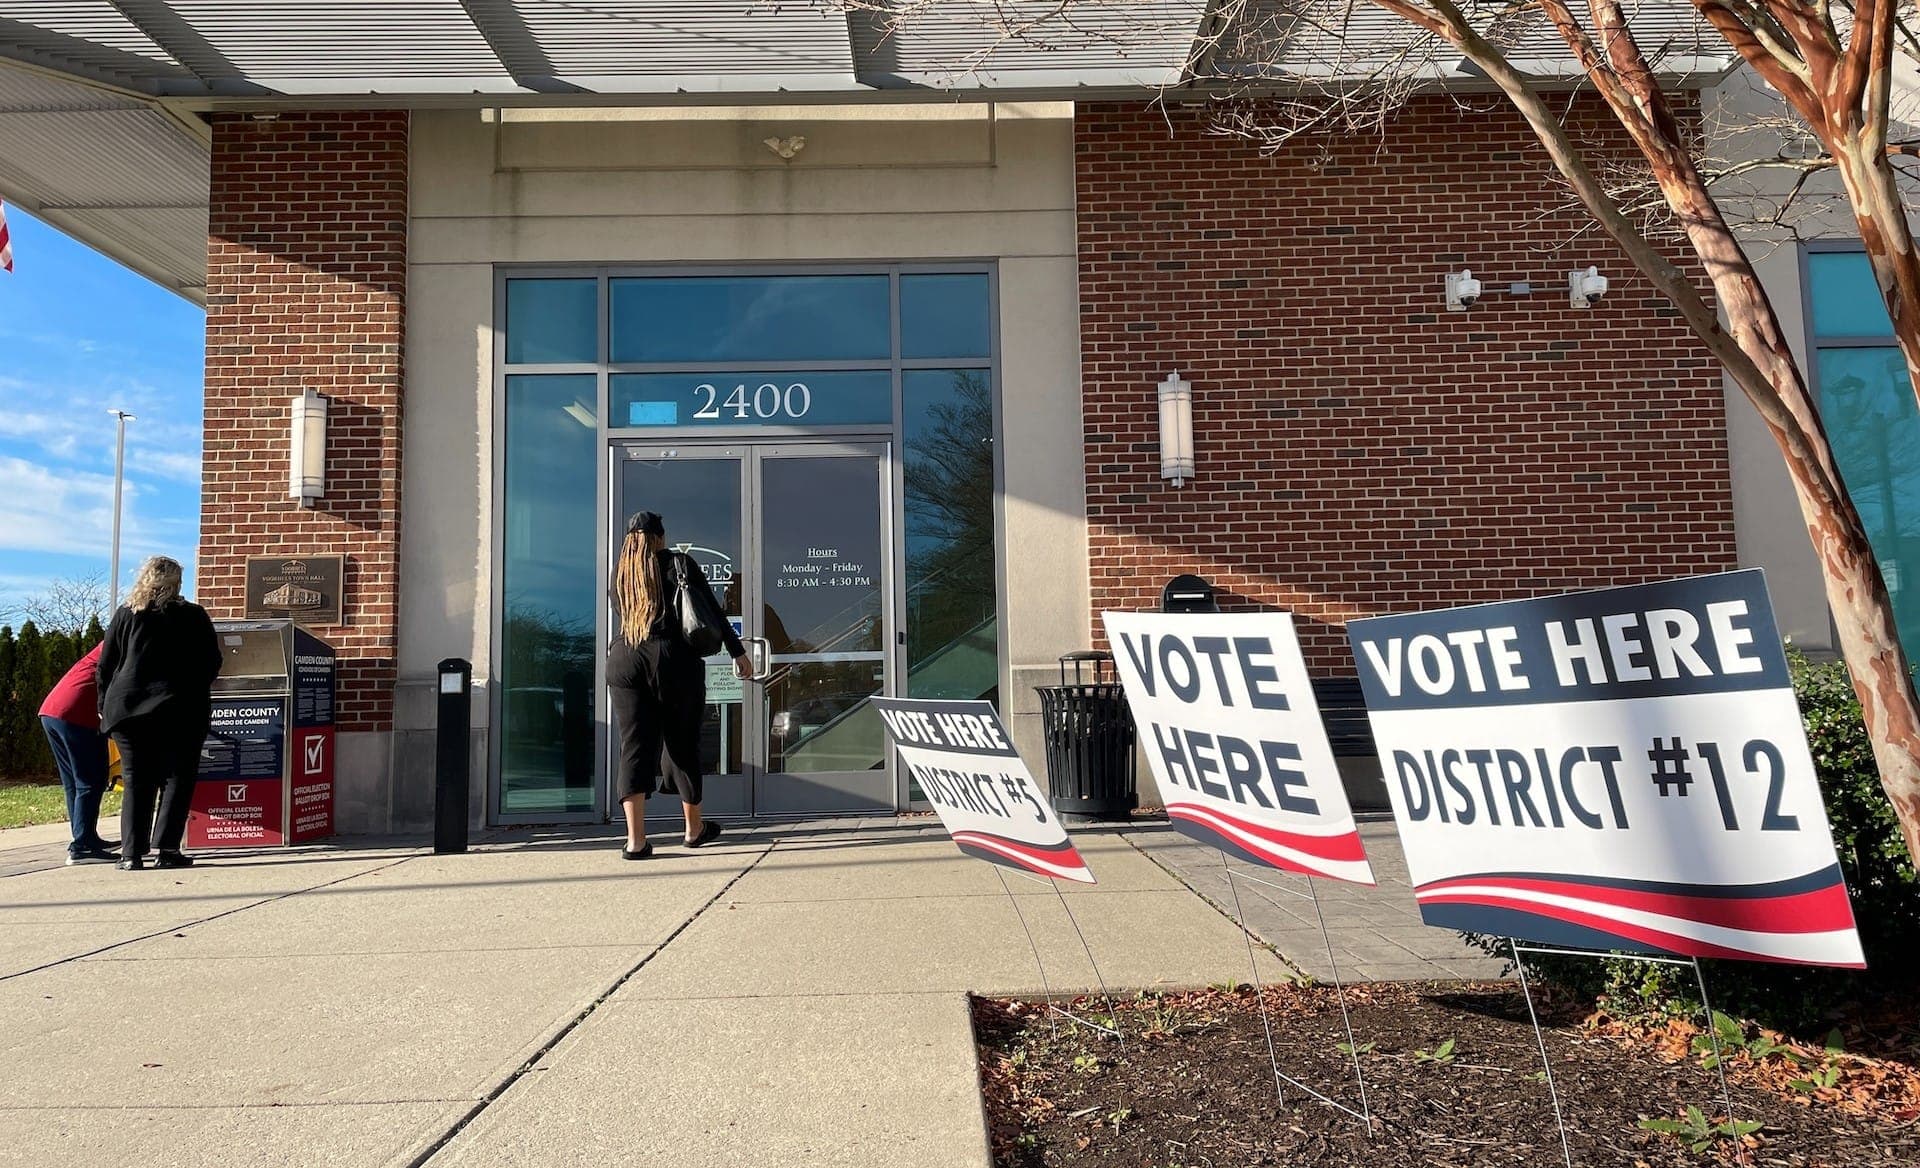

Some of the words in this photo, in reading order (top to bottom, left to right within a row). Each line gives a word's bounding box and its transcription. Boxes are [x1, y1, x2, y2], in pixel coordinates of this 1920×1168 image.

[693, 383, 811, 418] 2400
[782, 563, 822, 574] Monday
[832, 562, 863, 574] Friday
[808, 548, 837, 557] Hours
[777, 578, 799, 588] 8:30
[801, 578, 819, 587] AM
[829, 577, 852, 586] 4:30
[854, 576, 871, 586] PM
[294, 655, 315, 665] CAMDEN
[315, 655, 334, 665] COUNTY
[1362, 626, 1531, 697] VOTE
[1544, 600, 1763, 688] HERE
[1119, 632, 1291, 711] VOTE
[239, 707, 280, 717] COUNTY
[879, 708, 942, 745] VOTE
[934, 712, 1009, 750] HERE
[1151, 722, 1321, 816] HERE
[1393, 745, 1629, 830] DISTRICT
[1648, 736, 1800, 832] #12
[914, 764, 1011, 818] DISTRICT
[1000, 773, 1047, 824] #5
